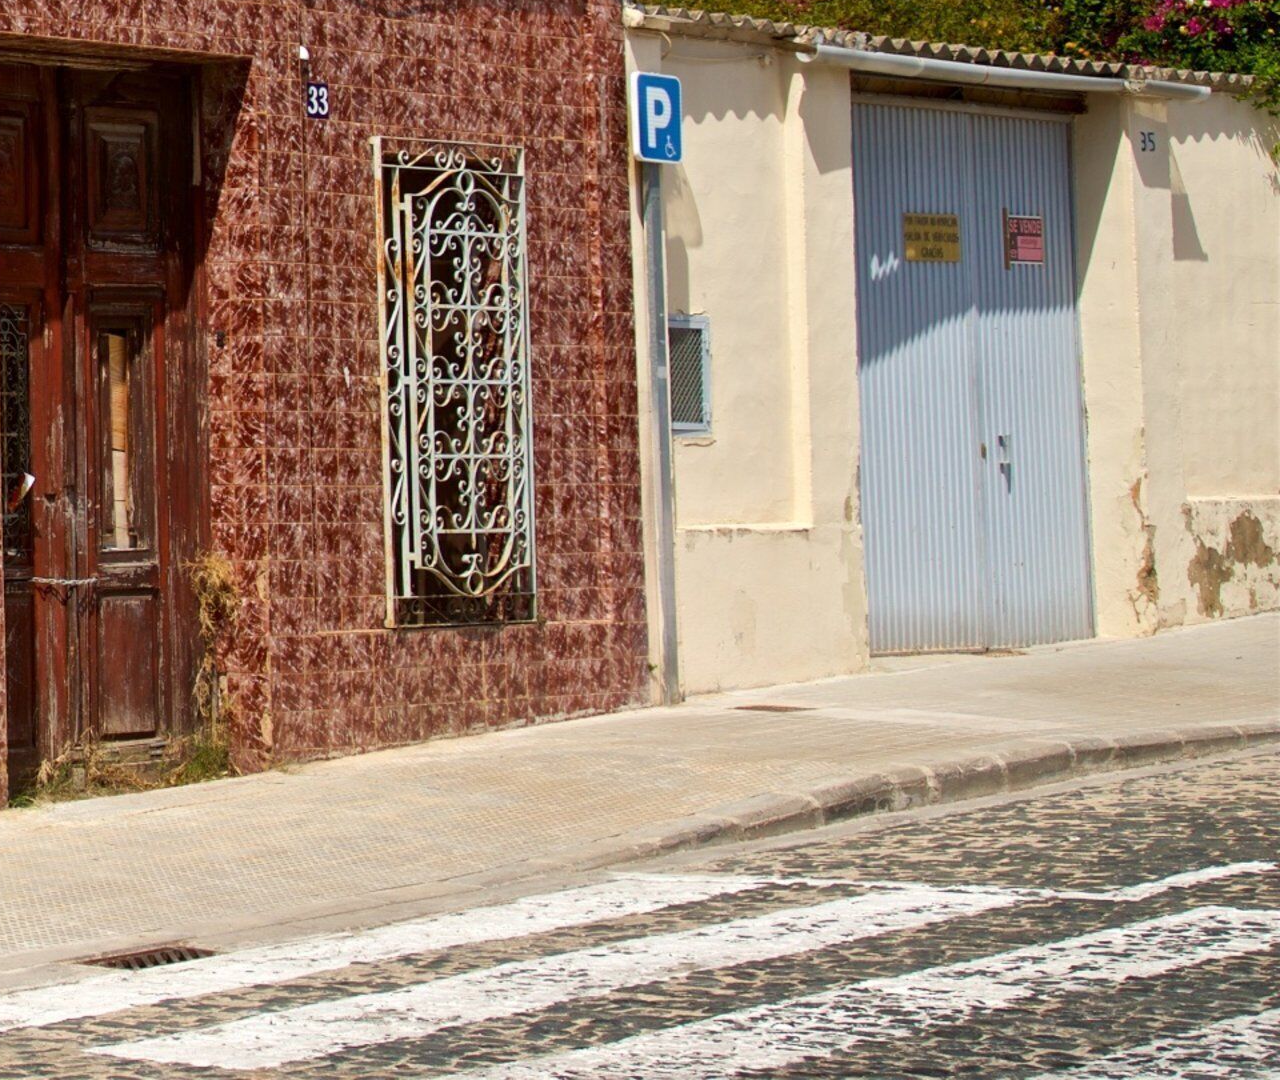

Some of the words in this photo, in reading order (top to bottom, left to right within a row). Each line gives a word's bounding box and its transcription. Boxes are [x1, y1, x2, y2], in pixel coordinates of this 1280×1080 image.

[308, 85, 329, 115] 33
[645, 85, 672, 149] P
[1140, 130, 1156, 152] 35
[1008, 219, 1018, 233] SE
[1019, 219, 1042, 235] VENDE
